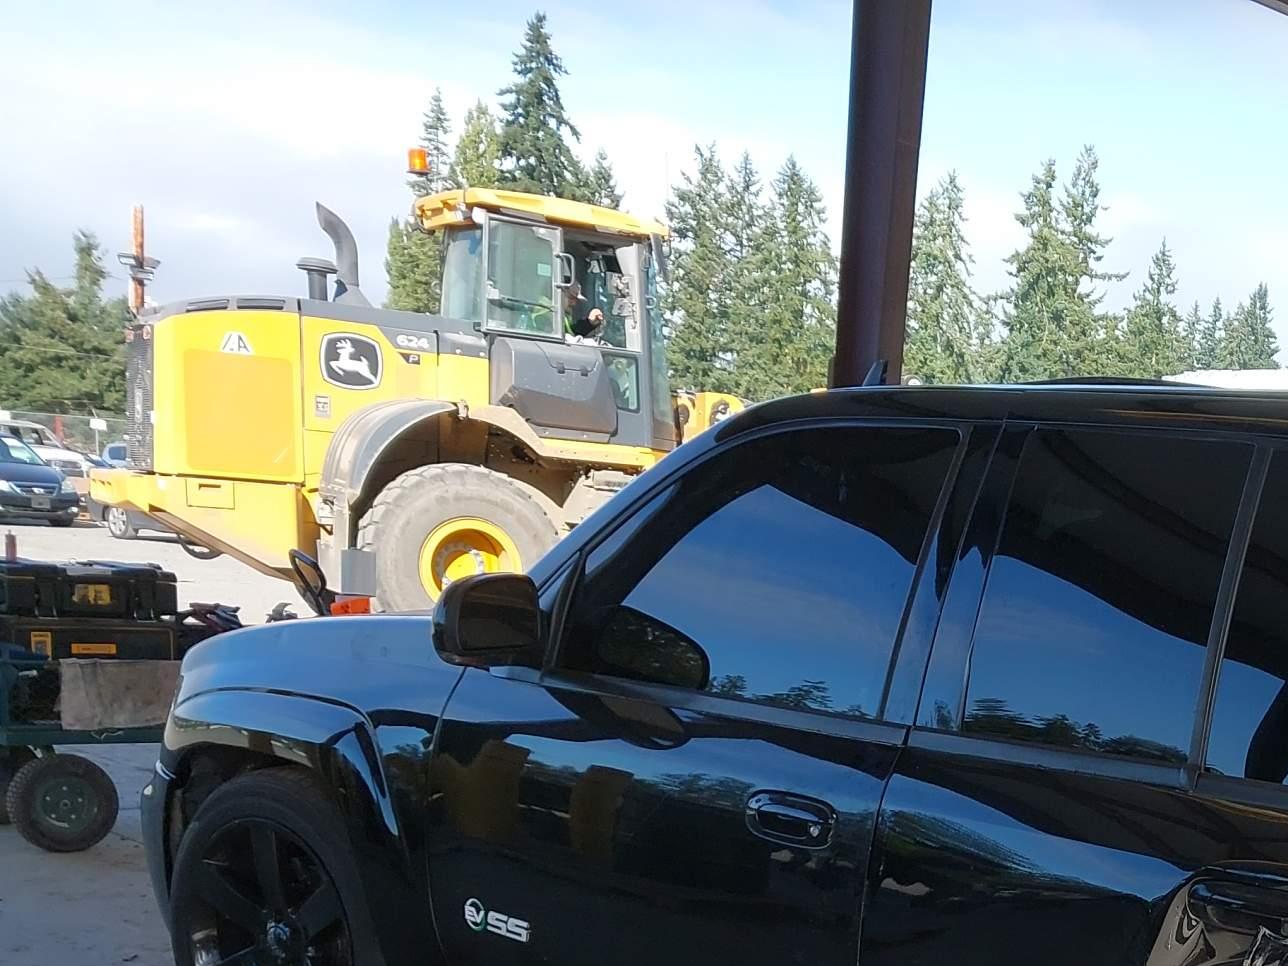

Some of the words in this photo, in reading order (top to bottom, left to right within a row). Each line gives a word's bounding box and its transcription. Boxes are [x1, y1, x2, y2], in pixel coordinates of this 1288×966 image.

[396, 334, 430, 349] 624
[408, 354, 420, 363] P
[486, 910, 530, 943] SS
